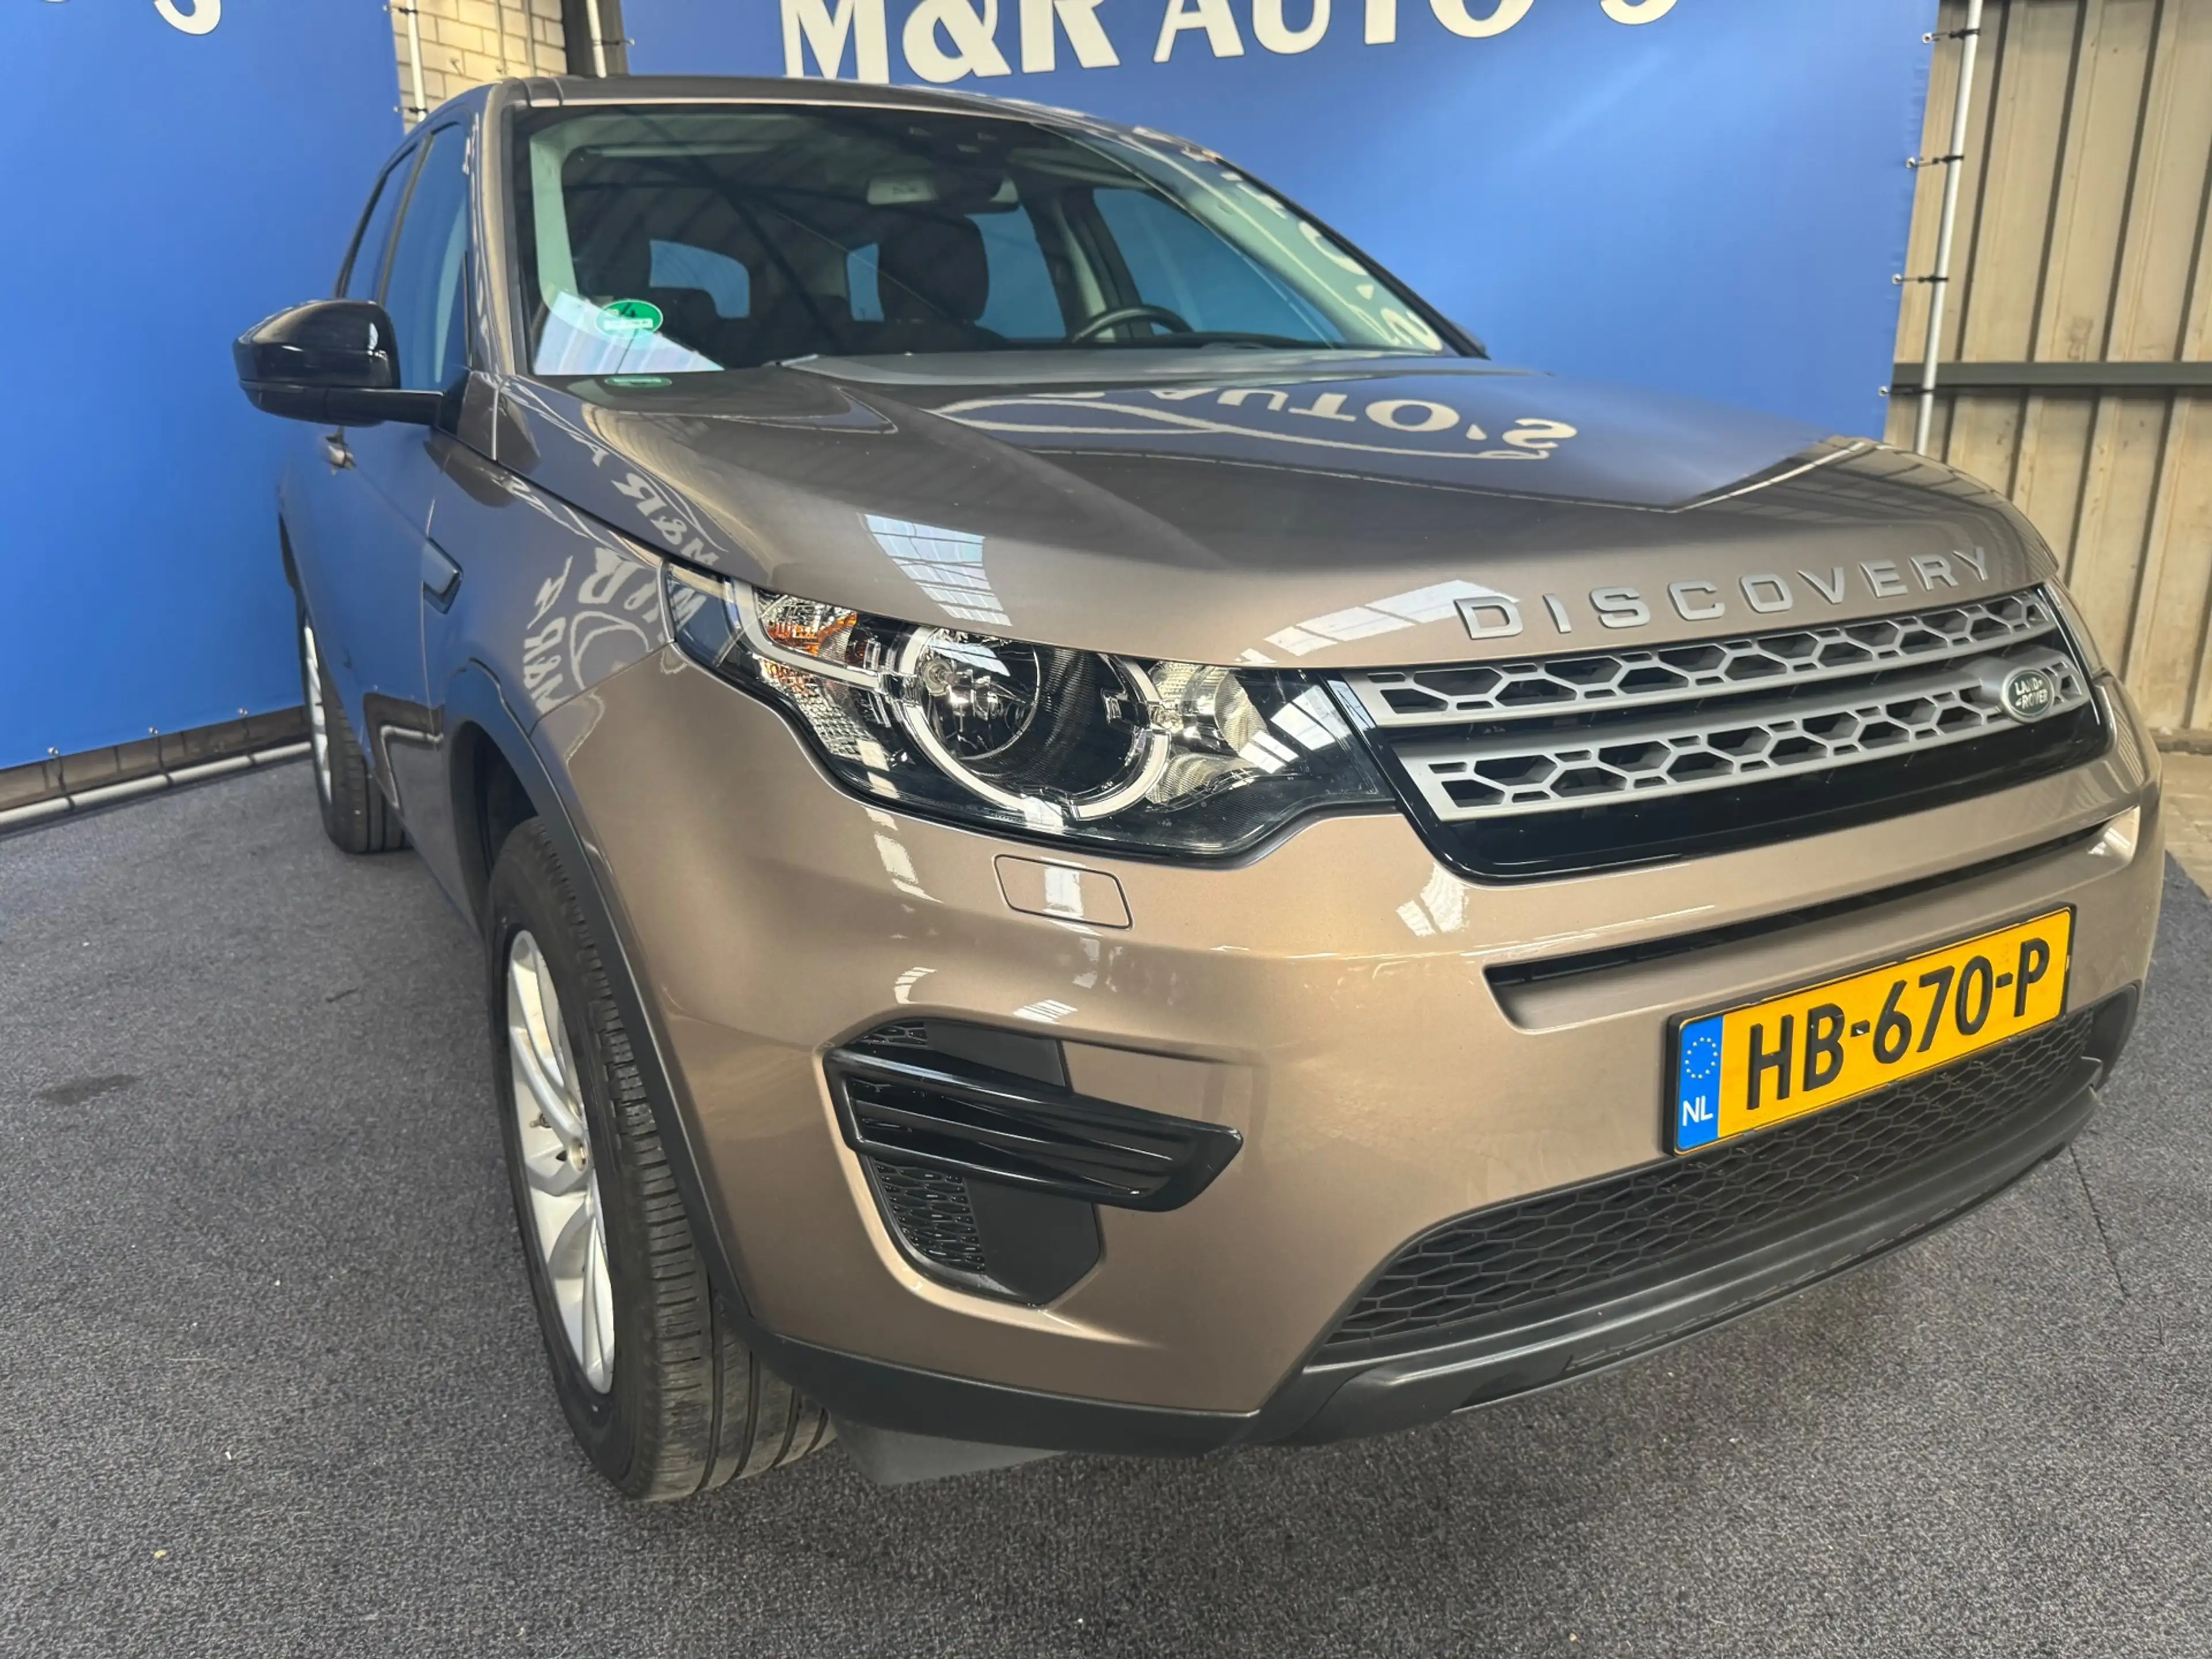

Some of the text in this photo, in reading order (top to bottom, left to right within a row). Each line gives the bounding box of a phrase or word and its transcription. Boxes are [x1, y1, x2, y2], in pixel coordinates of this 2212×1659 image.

[1455, 547, 1991, 639] DISCOVERY
[2014, 677, 2040, 696] LAND
[2022, 689, 2048, 709] ROVER
[1746, 937, 2050, 1111] HB-670-P
[1682, 1095, 1714, 1127] NL
